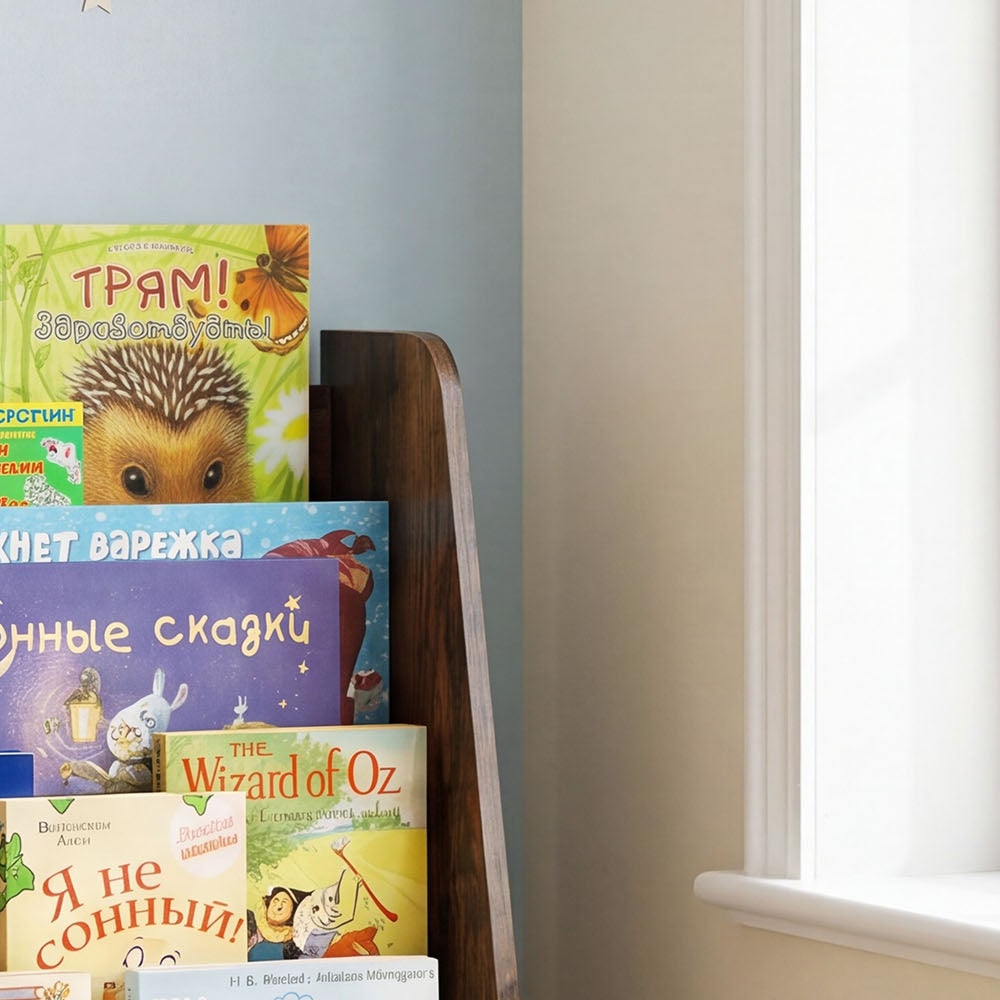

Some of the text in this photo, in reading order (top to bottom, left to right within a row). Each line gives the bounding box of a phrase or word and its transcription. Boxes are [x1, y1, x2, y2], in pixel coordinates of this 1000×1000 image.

[72, 259, 229, 309] ТРЯМ!
[181, 754, 299, 801] Wizard
[306, 747, 341, 798] of
[347, 750, 402, 796] Oz
[229, 742, 273, 757] THE
[41, 865, 84, 923] Я
